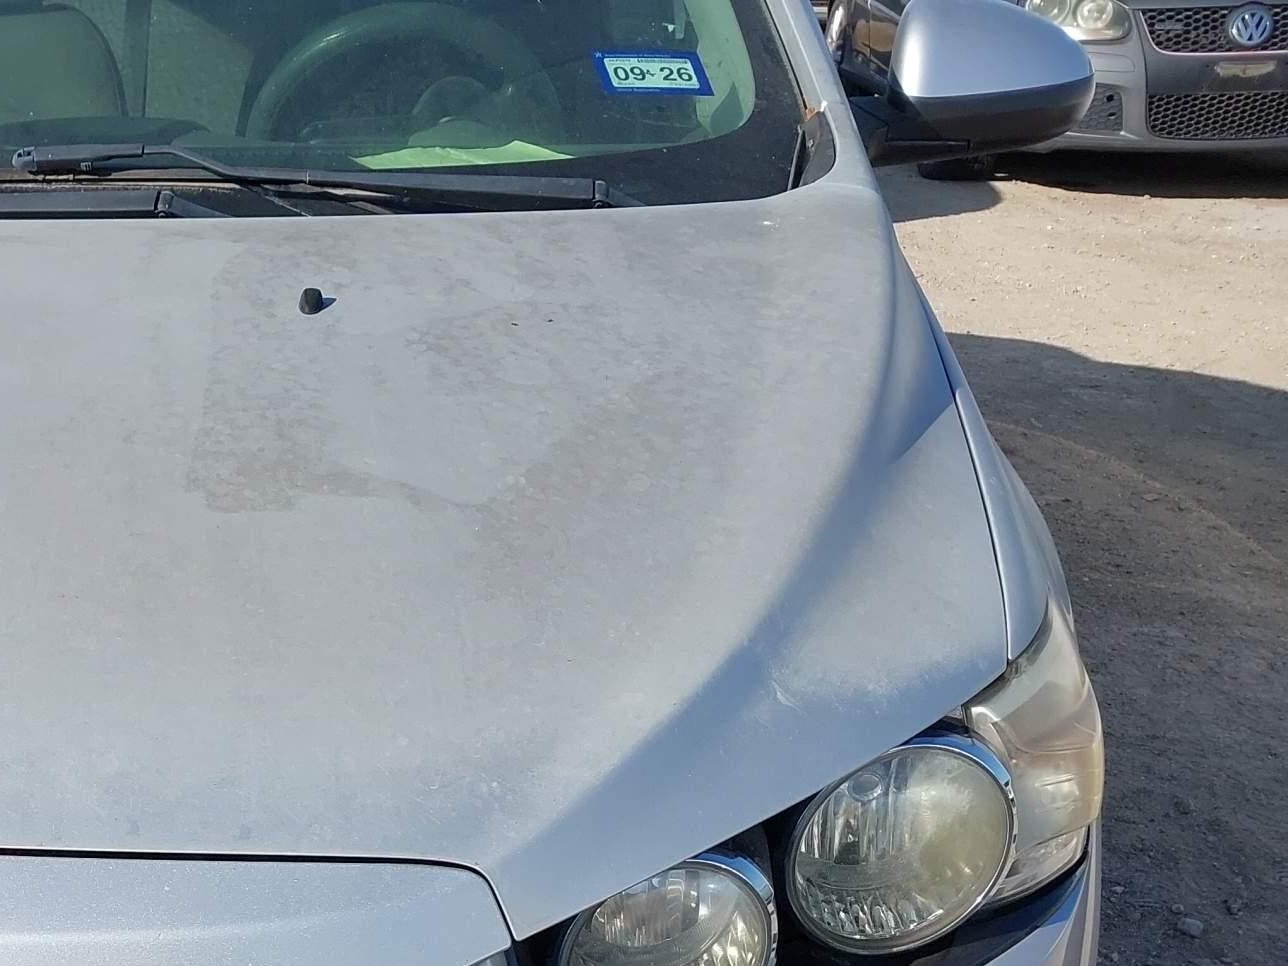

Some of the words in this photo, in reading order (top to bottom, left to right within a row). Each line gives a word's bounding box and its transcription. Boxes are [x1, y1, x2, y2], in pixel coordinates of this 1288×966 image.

[1235, 11, 1270, 43] VW
[613, 65, 646, 82] 09
[659, 66, 693, 82] 26
